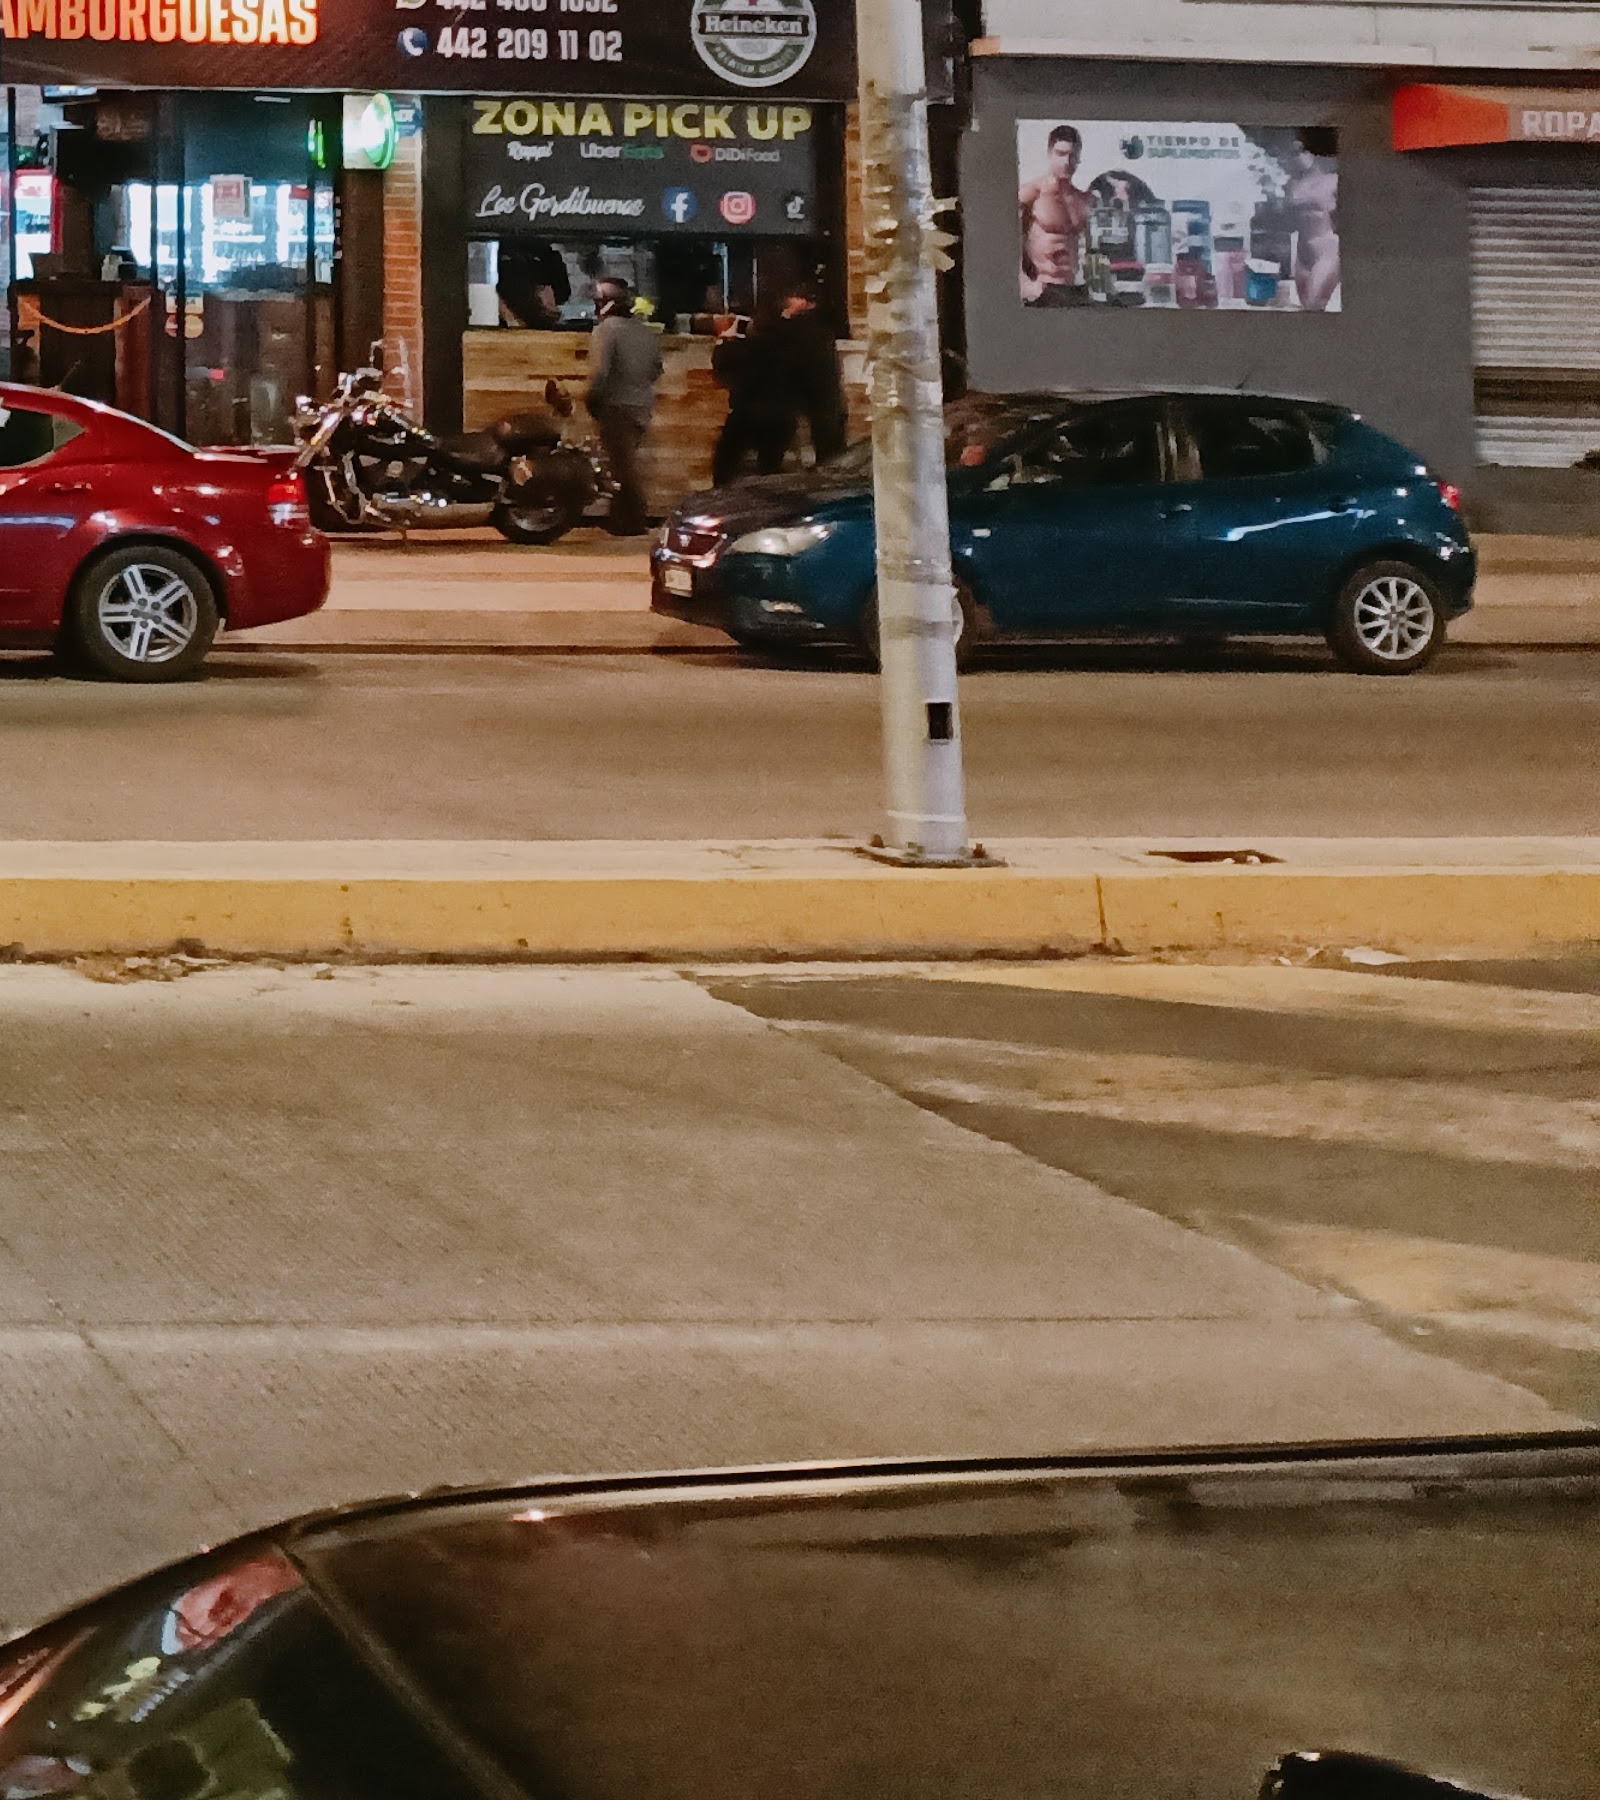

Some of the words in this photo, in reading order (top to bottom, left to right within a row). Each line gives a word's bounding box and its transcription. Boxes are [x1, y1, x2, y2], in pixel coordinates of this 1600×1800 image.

[704, 15, 803, 35] Heineken
[436, 26, 487, 59] 442
[497, 27, 548, 60] 209
[558, 29, 579, 61] 11
[588, 29, 623, 62] 02
[472, 100, 613, 137] ZONA
[624, 103, 736, 139] PICK
[747, 105, 812, 141] UP
[580, 142, 622, 159] Uber
[475, 185, 516, 217] Las
[520, 183, 645, 221] Gordibuenas
